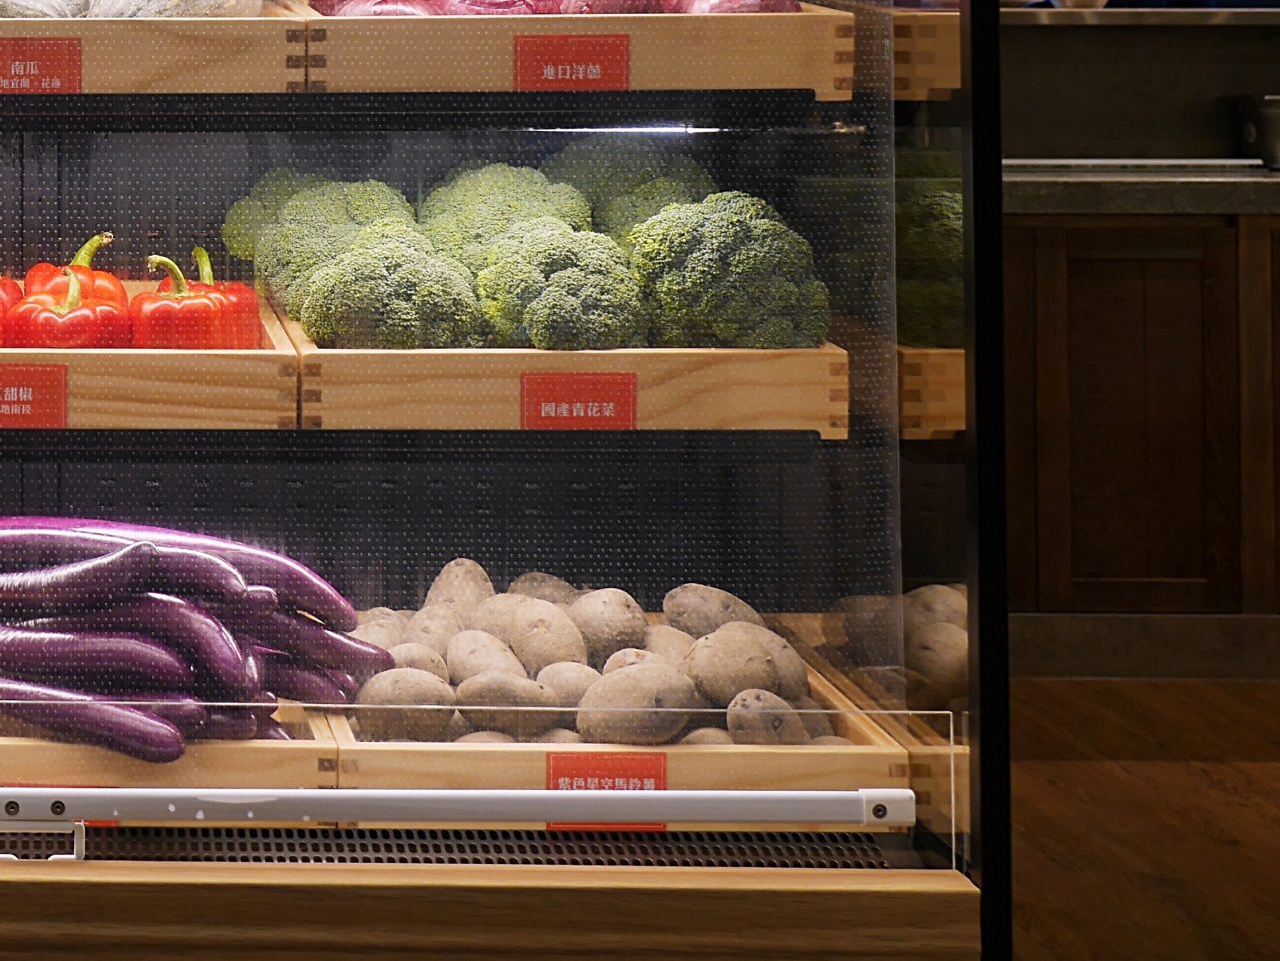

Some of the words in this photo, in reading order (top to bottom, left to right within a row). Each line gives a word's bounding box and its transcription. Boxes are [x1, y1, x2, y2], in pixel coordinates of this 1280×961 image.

[10, 61, 40, 75] 南瓜
[542, 63, 601, 80] 進口洋蔥
[540, 402, 615, 417] 國產青花菜
